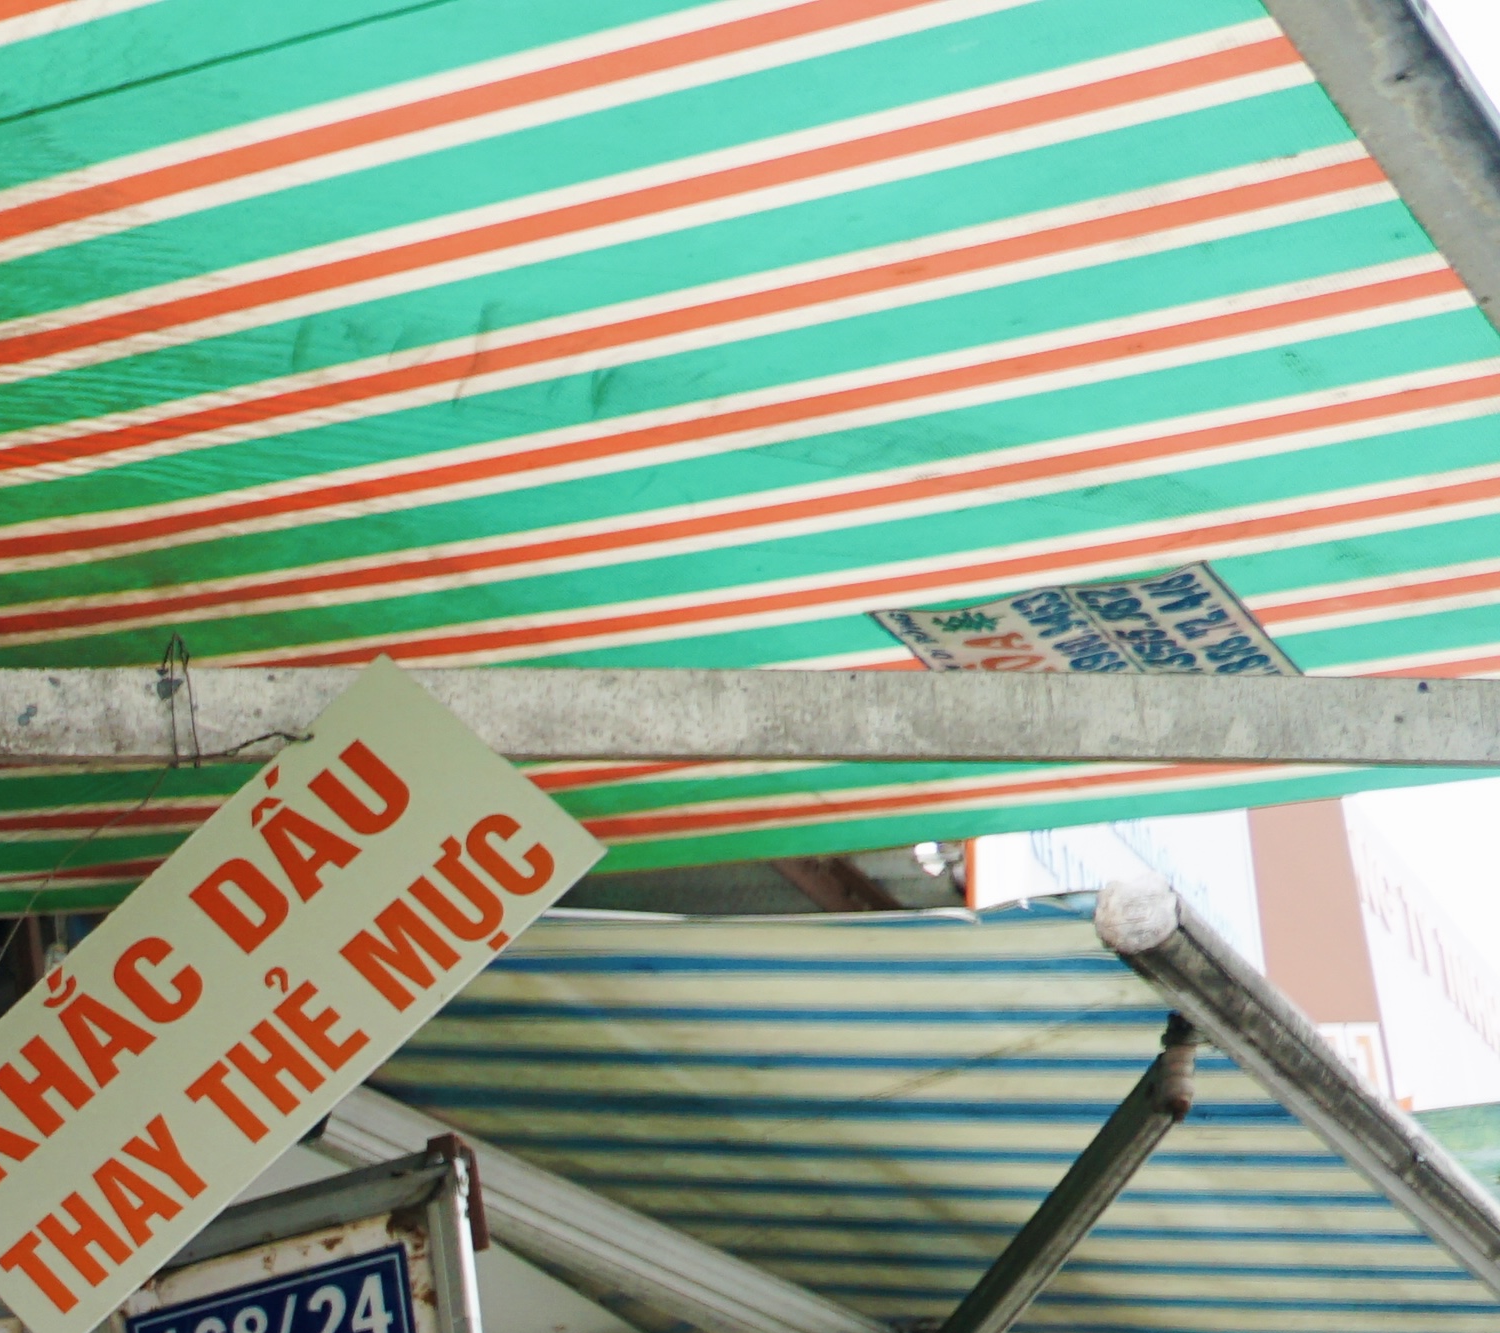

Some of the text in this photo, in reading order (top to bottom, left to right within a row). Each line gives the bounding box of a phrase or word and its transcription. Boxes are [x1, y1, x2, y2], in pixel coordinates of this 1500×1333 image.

[183, 964, 372, 1145] THẺ
[338, 813, 557, 1014] MỰC
[187, 738, 411, 956] DẤU
